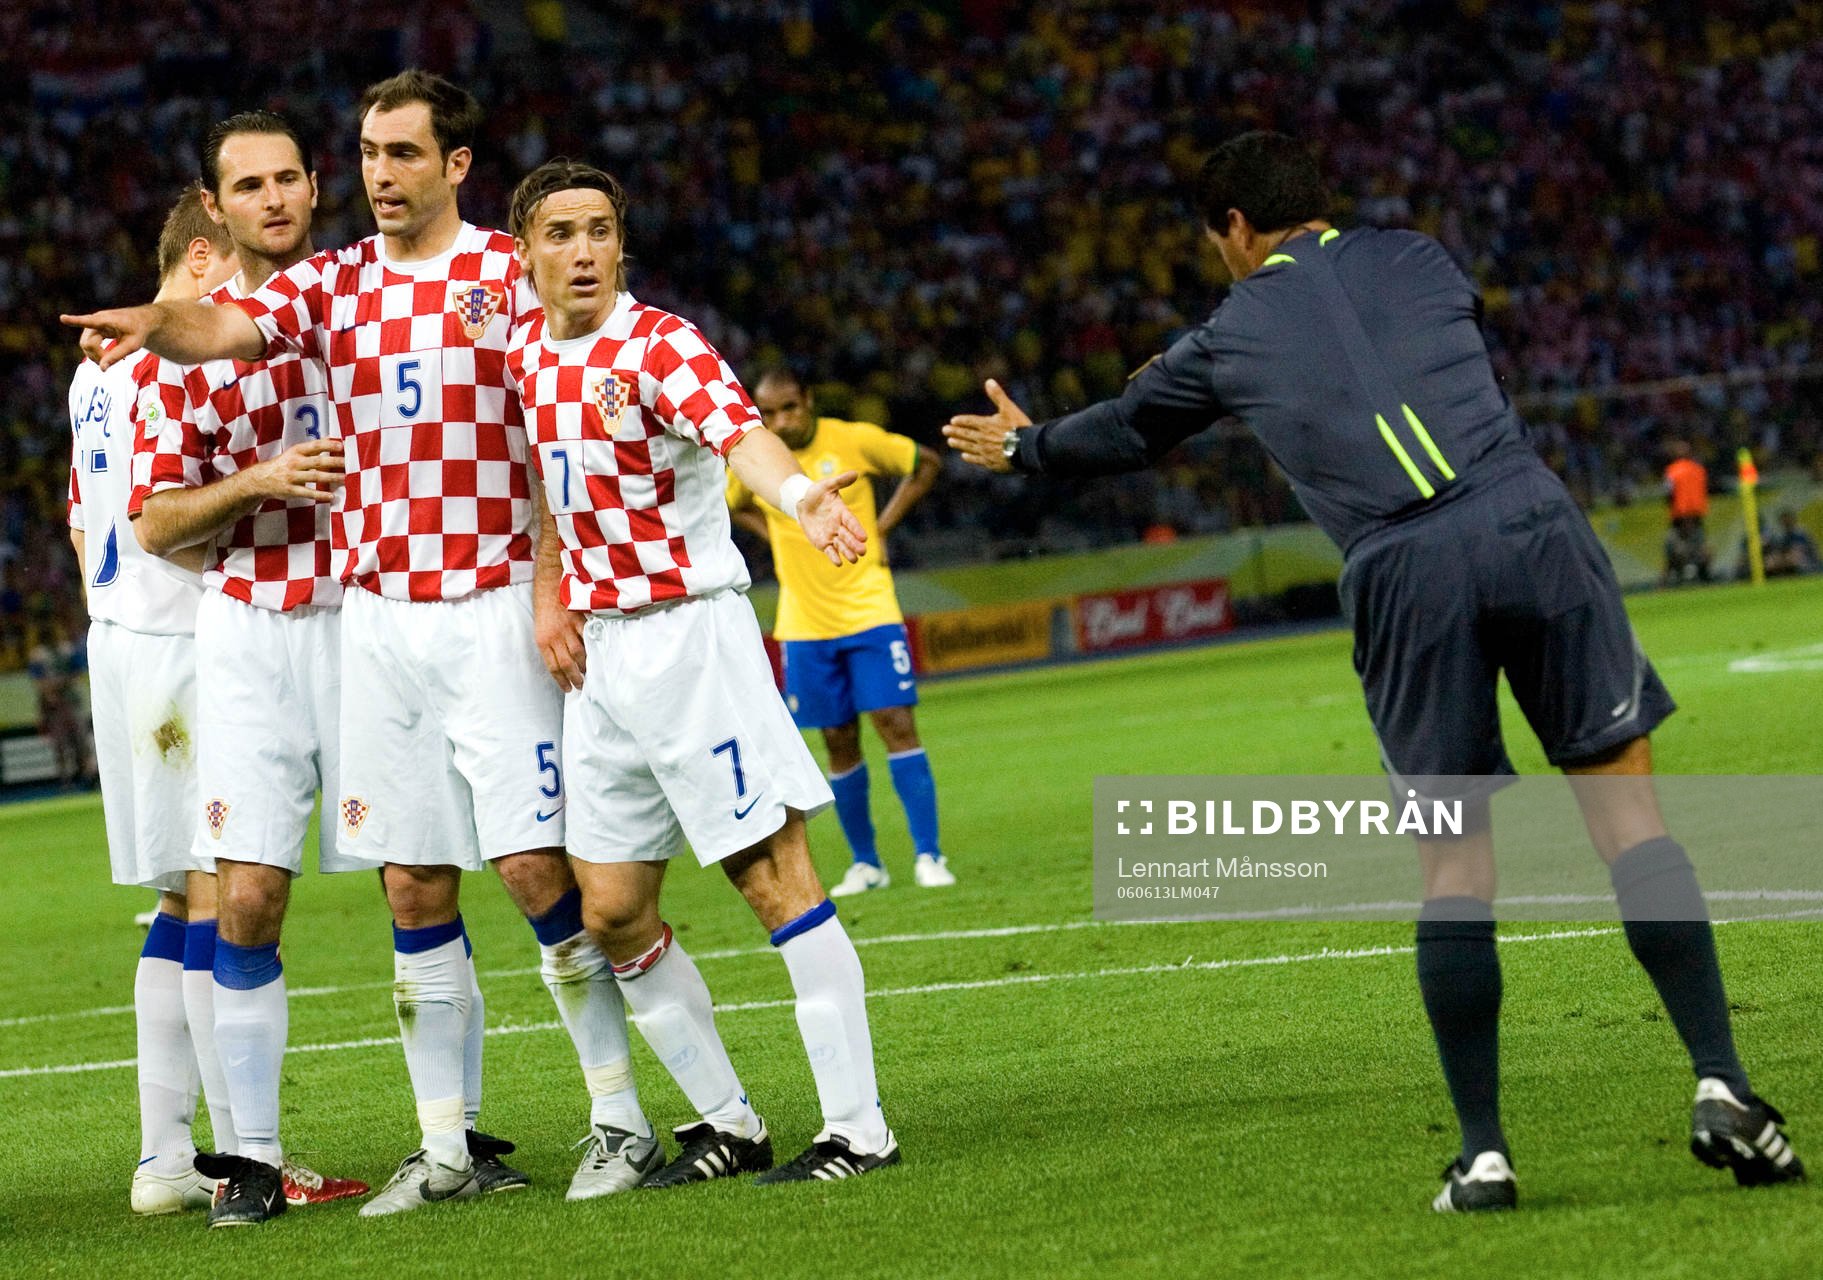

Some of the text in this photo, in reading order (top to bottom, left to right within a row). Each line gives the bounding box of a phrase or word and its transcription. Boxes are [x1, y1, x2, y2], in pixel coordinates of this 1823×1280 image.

[473, 292, 482, 319] HNS
[396, 358, 421, 420] 5
[550, 448, 570, 509] 7
[889, 640, 911, 674] 5
[535, 740, 563, 800] 5
[709, 736, 748, 800] 7
